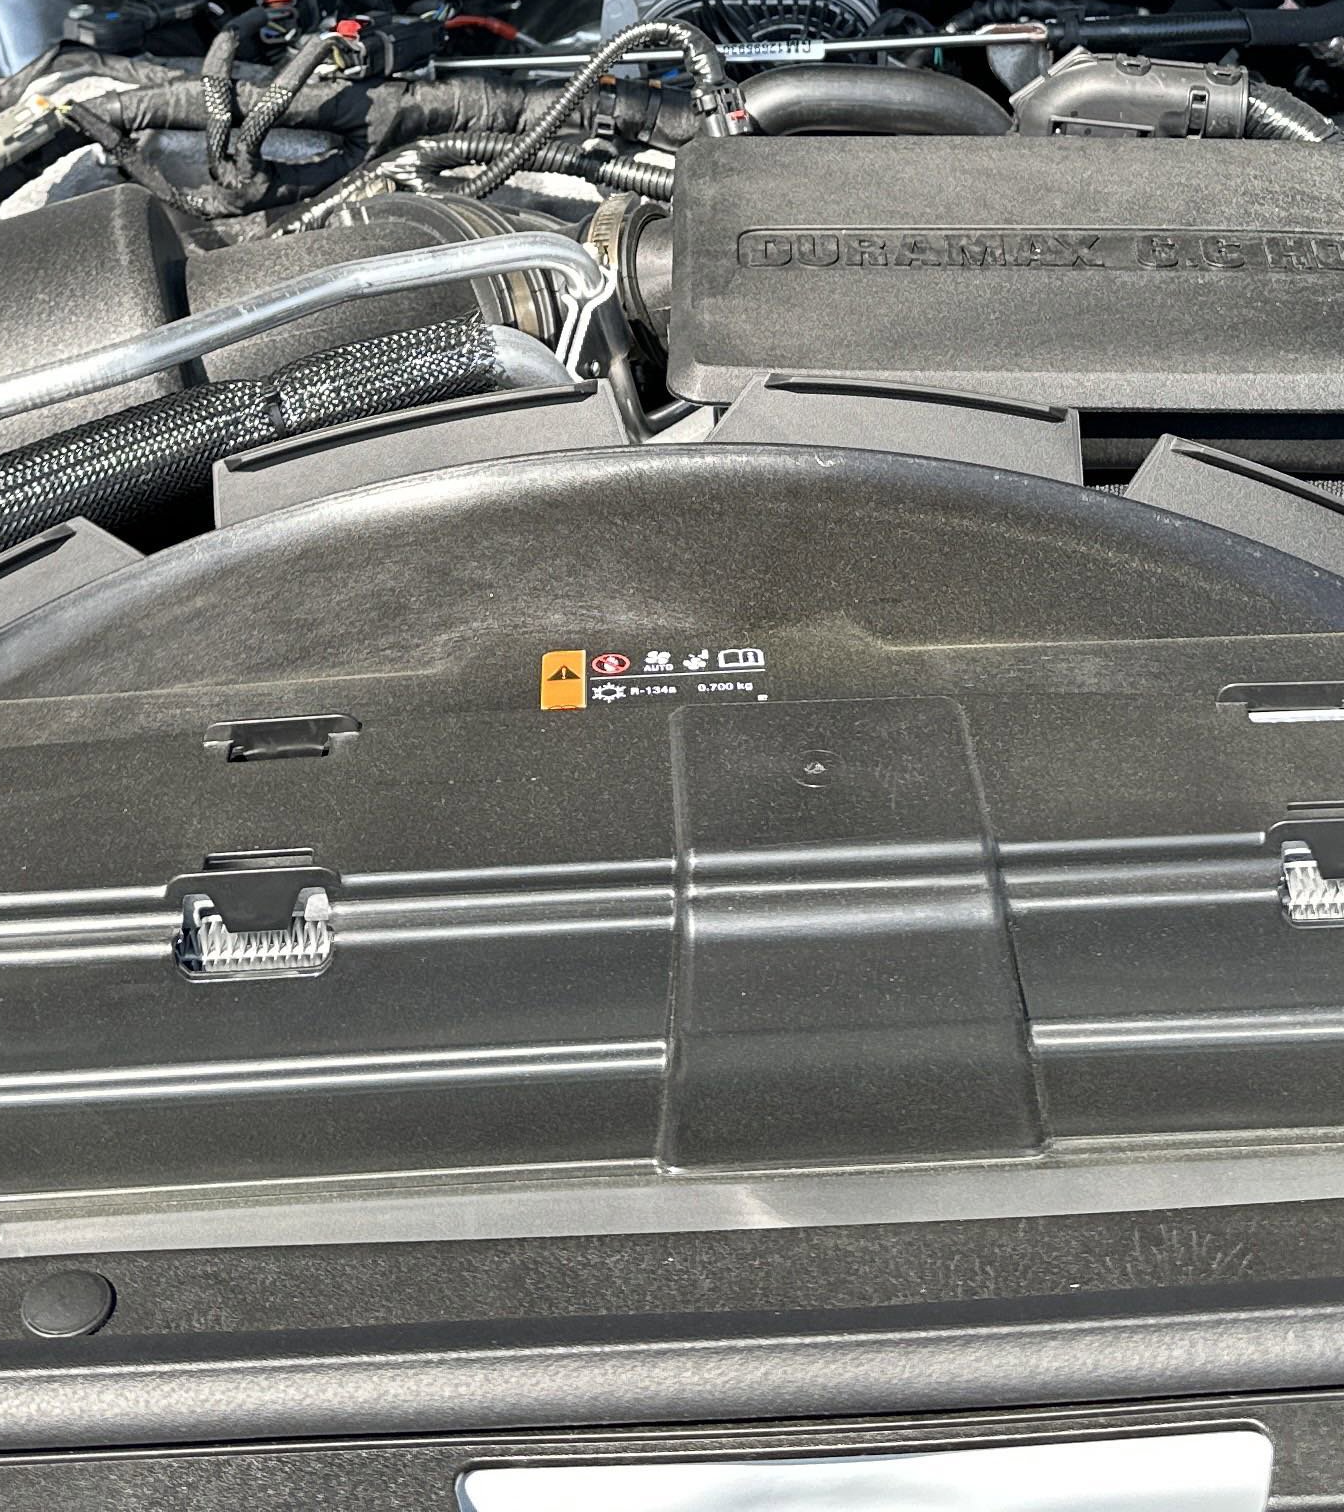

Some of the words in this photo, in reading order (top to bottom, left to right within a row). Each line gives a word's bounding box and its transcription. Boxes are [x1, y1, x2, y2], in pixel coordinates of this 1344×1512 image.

[748, 234, 1105, 268] DURAMAX
[643, 663, 674, 672] AUTO
[630, 685, 678, 696] R-134a
[697, 682, 734, 692] 0.700
[736, 681, 754, 691] kg
